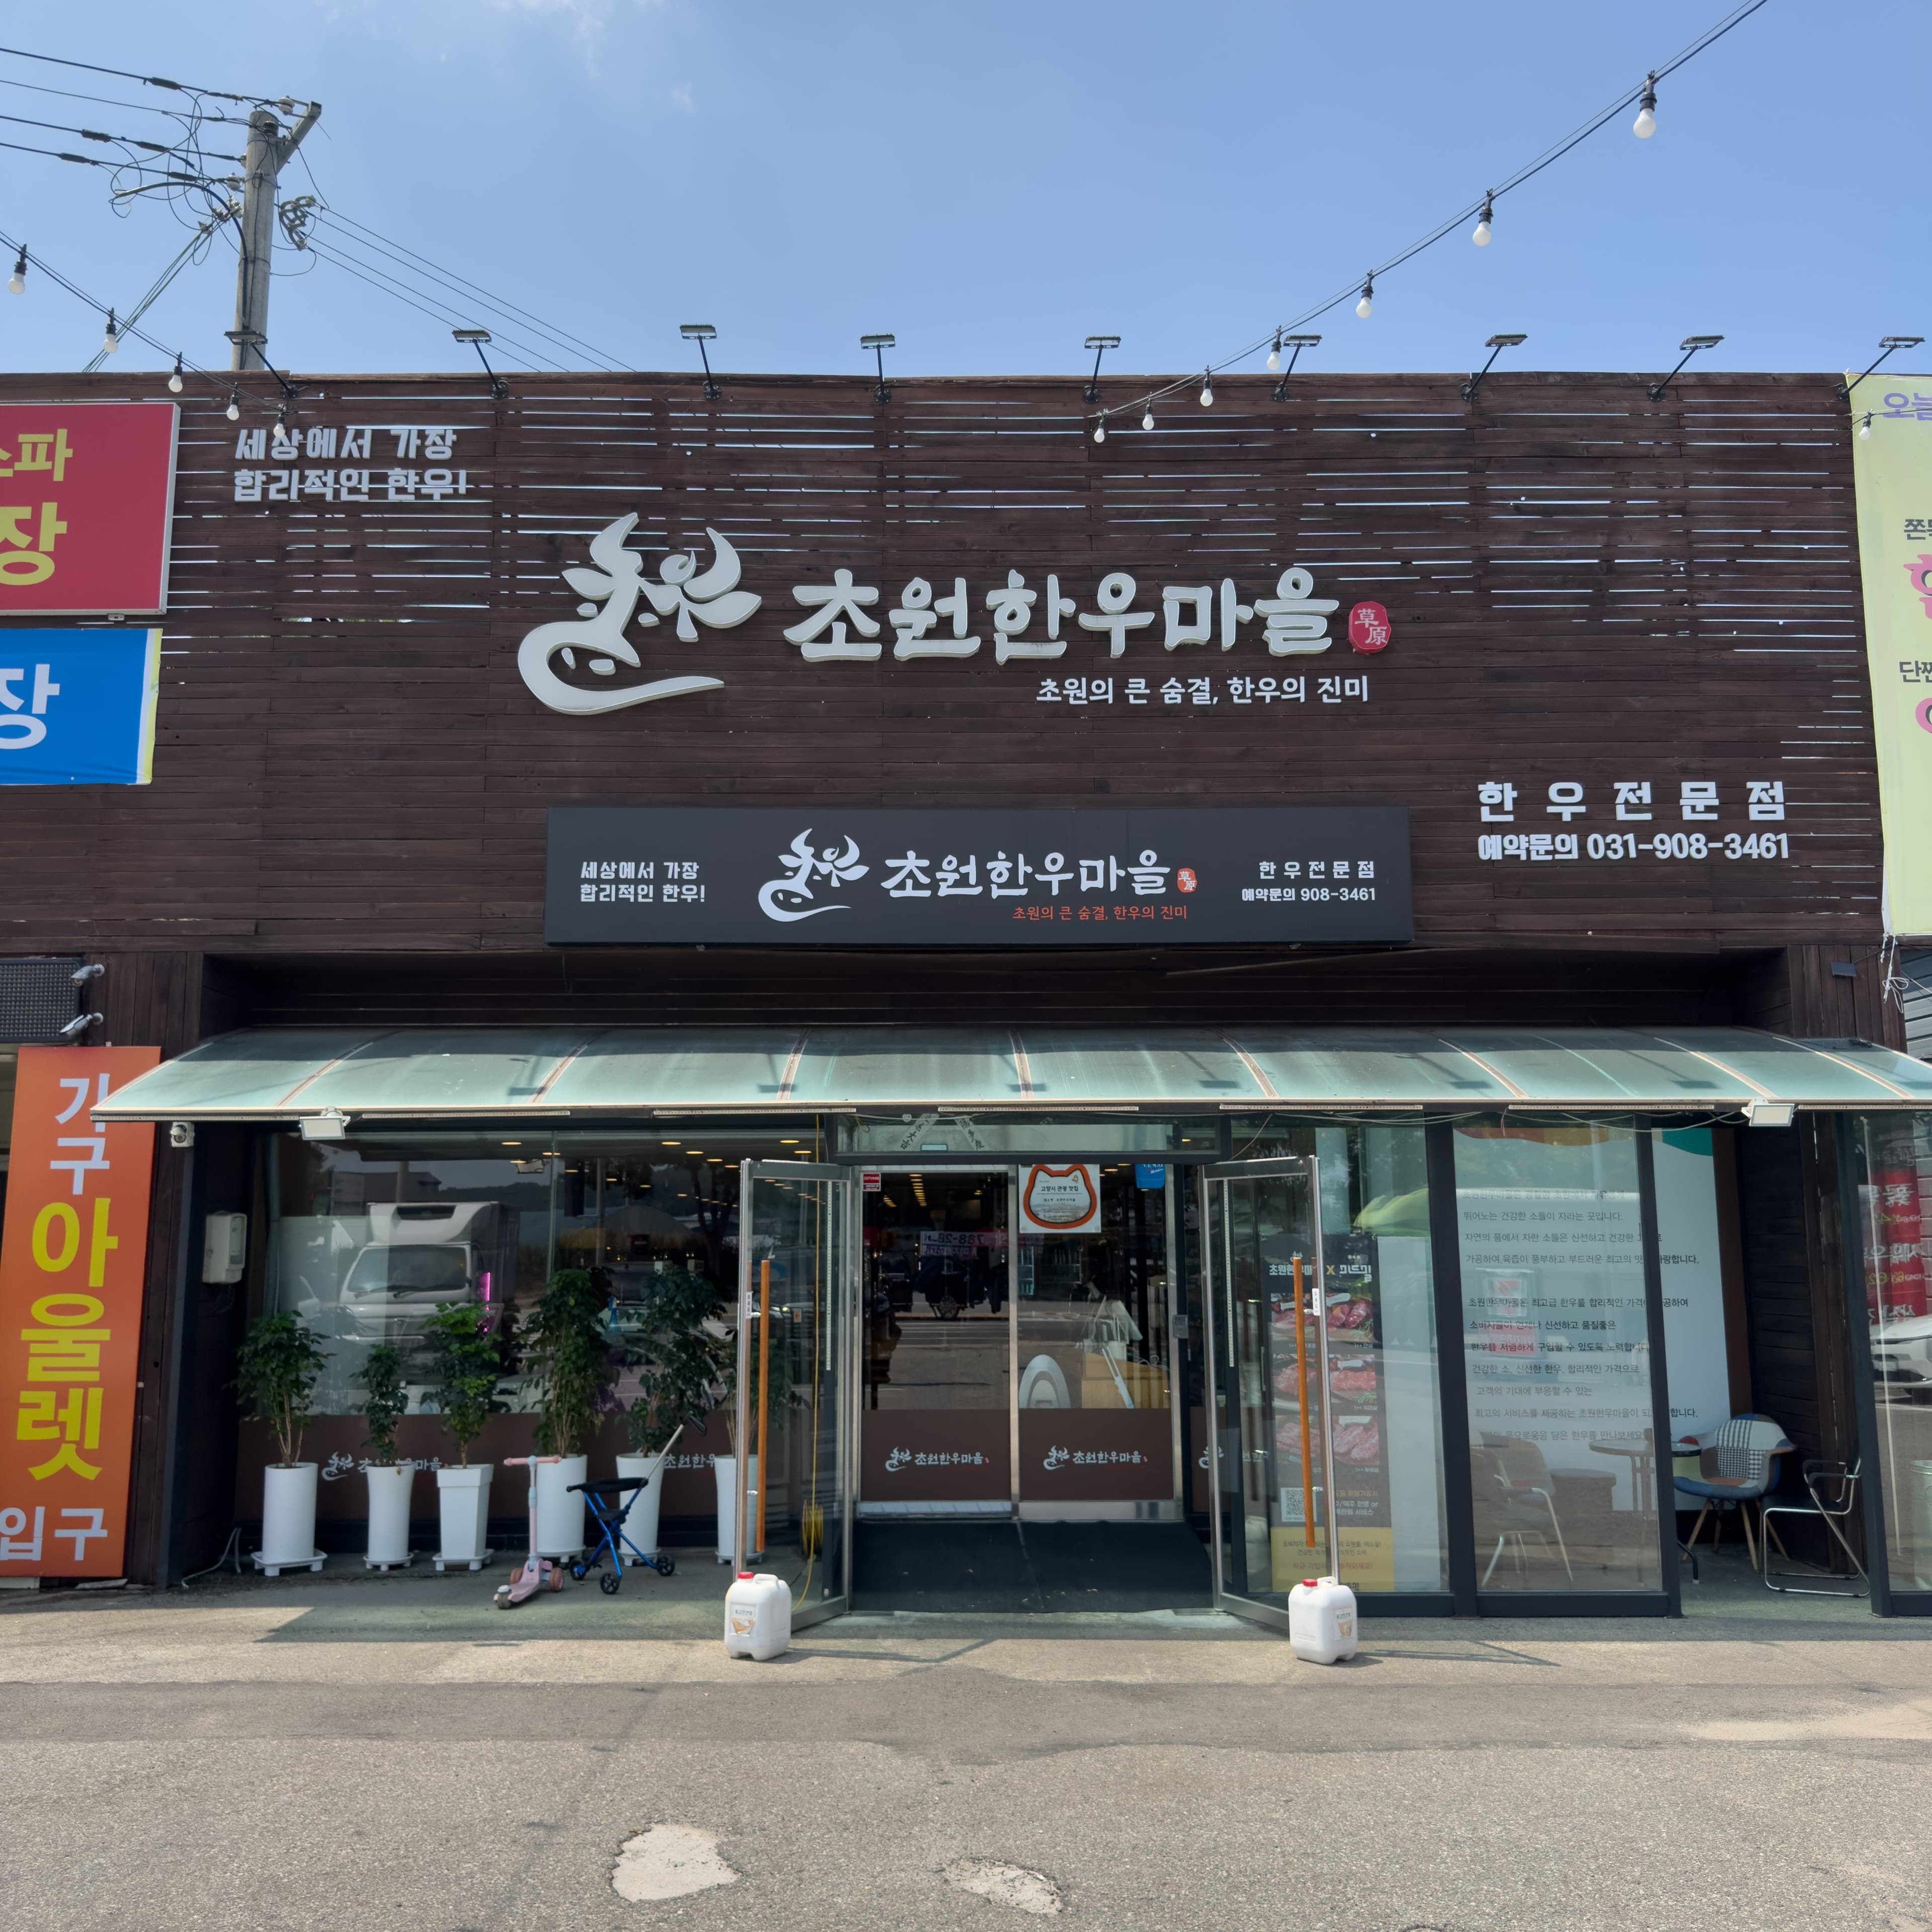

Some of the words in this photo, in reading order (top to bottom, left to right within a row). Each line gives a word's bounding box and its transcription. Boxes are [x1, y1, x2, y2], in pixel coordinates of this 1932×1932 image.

[235, 428, 371, 460] 세상에서
[391, 429, 457, 460] 가장
[234, 469, 370, 501] 합리적인
[387, 469, 466, 501] 한우!
[1903, 519, 1932, 540] 쫀
[783, 567, 1339, 665] 초원한우마을
[1037, 678, 1112, 704] 초원의
[1125, 679, 1150, 703] 큰
[1160, 678, 1219, 704] 숨결,
[1228, 677, 1305, 703] 한우의
[1318, 676, 1367, 702] 진미
[1478, 834, 1578, 860] 예약문의
[1587, 833, 1788, 859] 031-908-3461
[581, 862, 654, 878] 세상에서
[664, 862, 699, 879] 가장
[881, 850, 1170, 899] 초원한우마을
[581, 884, 653, 902] 합리적인
[663, 884, 704, 902] 한우!
[1242, 889, 1295, 901] 예약문의
[1301, 888, 1375, 901] 908-3461
[1013, 907, 1053, 920] 초원의
[1059, 908, 1072, 920] 큰
[1078, 907, 1108, 921] 숨결,
[1113, 906, 1154, 919] 한우의
[1160, 906, 1187, 919] 진미
[1464, 1212, 1497, 1221] 뛰어노는
[1501, 1212, 1525, 1221] 건강한
[1530, 1212, 1555, 1221] 소들이
[1558, 1212, 1583, 1221] 자라는
[1465, 1233, 1490, 1242] 자연의
[1493, 1233, 1518, 1242] 품에서
[1523, 1233, 1539, 1242] 자란
[1543, 1233, 1568, 1242] 소들은
[1572, 1233, 1605, 1242] 신선하고
[1608, 1233, 1634, 1242] 건강한
[1532, 1255, 1566, 1264] 풍부하고
[1569, 1255, 1602, 1264] 부드러운
[1606, 1255, 1631, 1264] 최고의
[1269, 1264, 1312, 1275] 초원한마
[1532, 1298, 1556, 1307] 최고급
[1561, 1298, 1585, 1307] 한우를
[1589, 1298, 1623, 1307] 합리적인
[1627, 1298, 1646, 1307] 가격
[1662, 1298, 1688, 1307] 공하여
[1545, 1321, 1578, 1330] 신선하고
[1582, 1321, 1616, 1330] 품질좋은
[1500, 1342, 1534, 1352] 저렴하게
[1538, 1342, 1562, 1352] 구입할
[1566, 1342, 1574, 1352] 수
[1578, 1342, 1603, 1352] 있도록
[1473, 1364, 1498, 1374] 건강한
[1516, 1364, 1541, 1374] 신선한
[1568, 1364, 1601, 1374] 합리적인
[1605, 1364, 1639, 1374] 가격으로
[1477, 1386, 1502, 1396] 고객의
[1506, 1386, 1531, 1396] 기대에
[1535, 1386, 1560, 1396] 부응할
[1563, 1386, 1572, 1396] 수
[1575, 1386, 1592, 1396] 있는
[1475, 1409, 1500, 1418] 최고의
[1504, 1409, 1538, 1418] 서비스를
[1542, 1409, 1575, 1418] 제공하는
[1579, 1409, 1638, 1418] 초원한우마을이
[914, 1452, 984, 1465] 초원한우마을
[1072, 1451, 1142, 1464] 초원한우마을
[357, 1457, 442, 1472] 초마을
[0, 1506, 108, 1561] 입구
